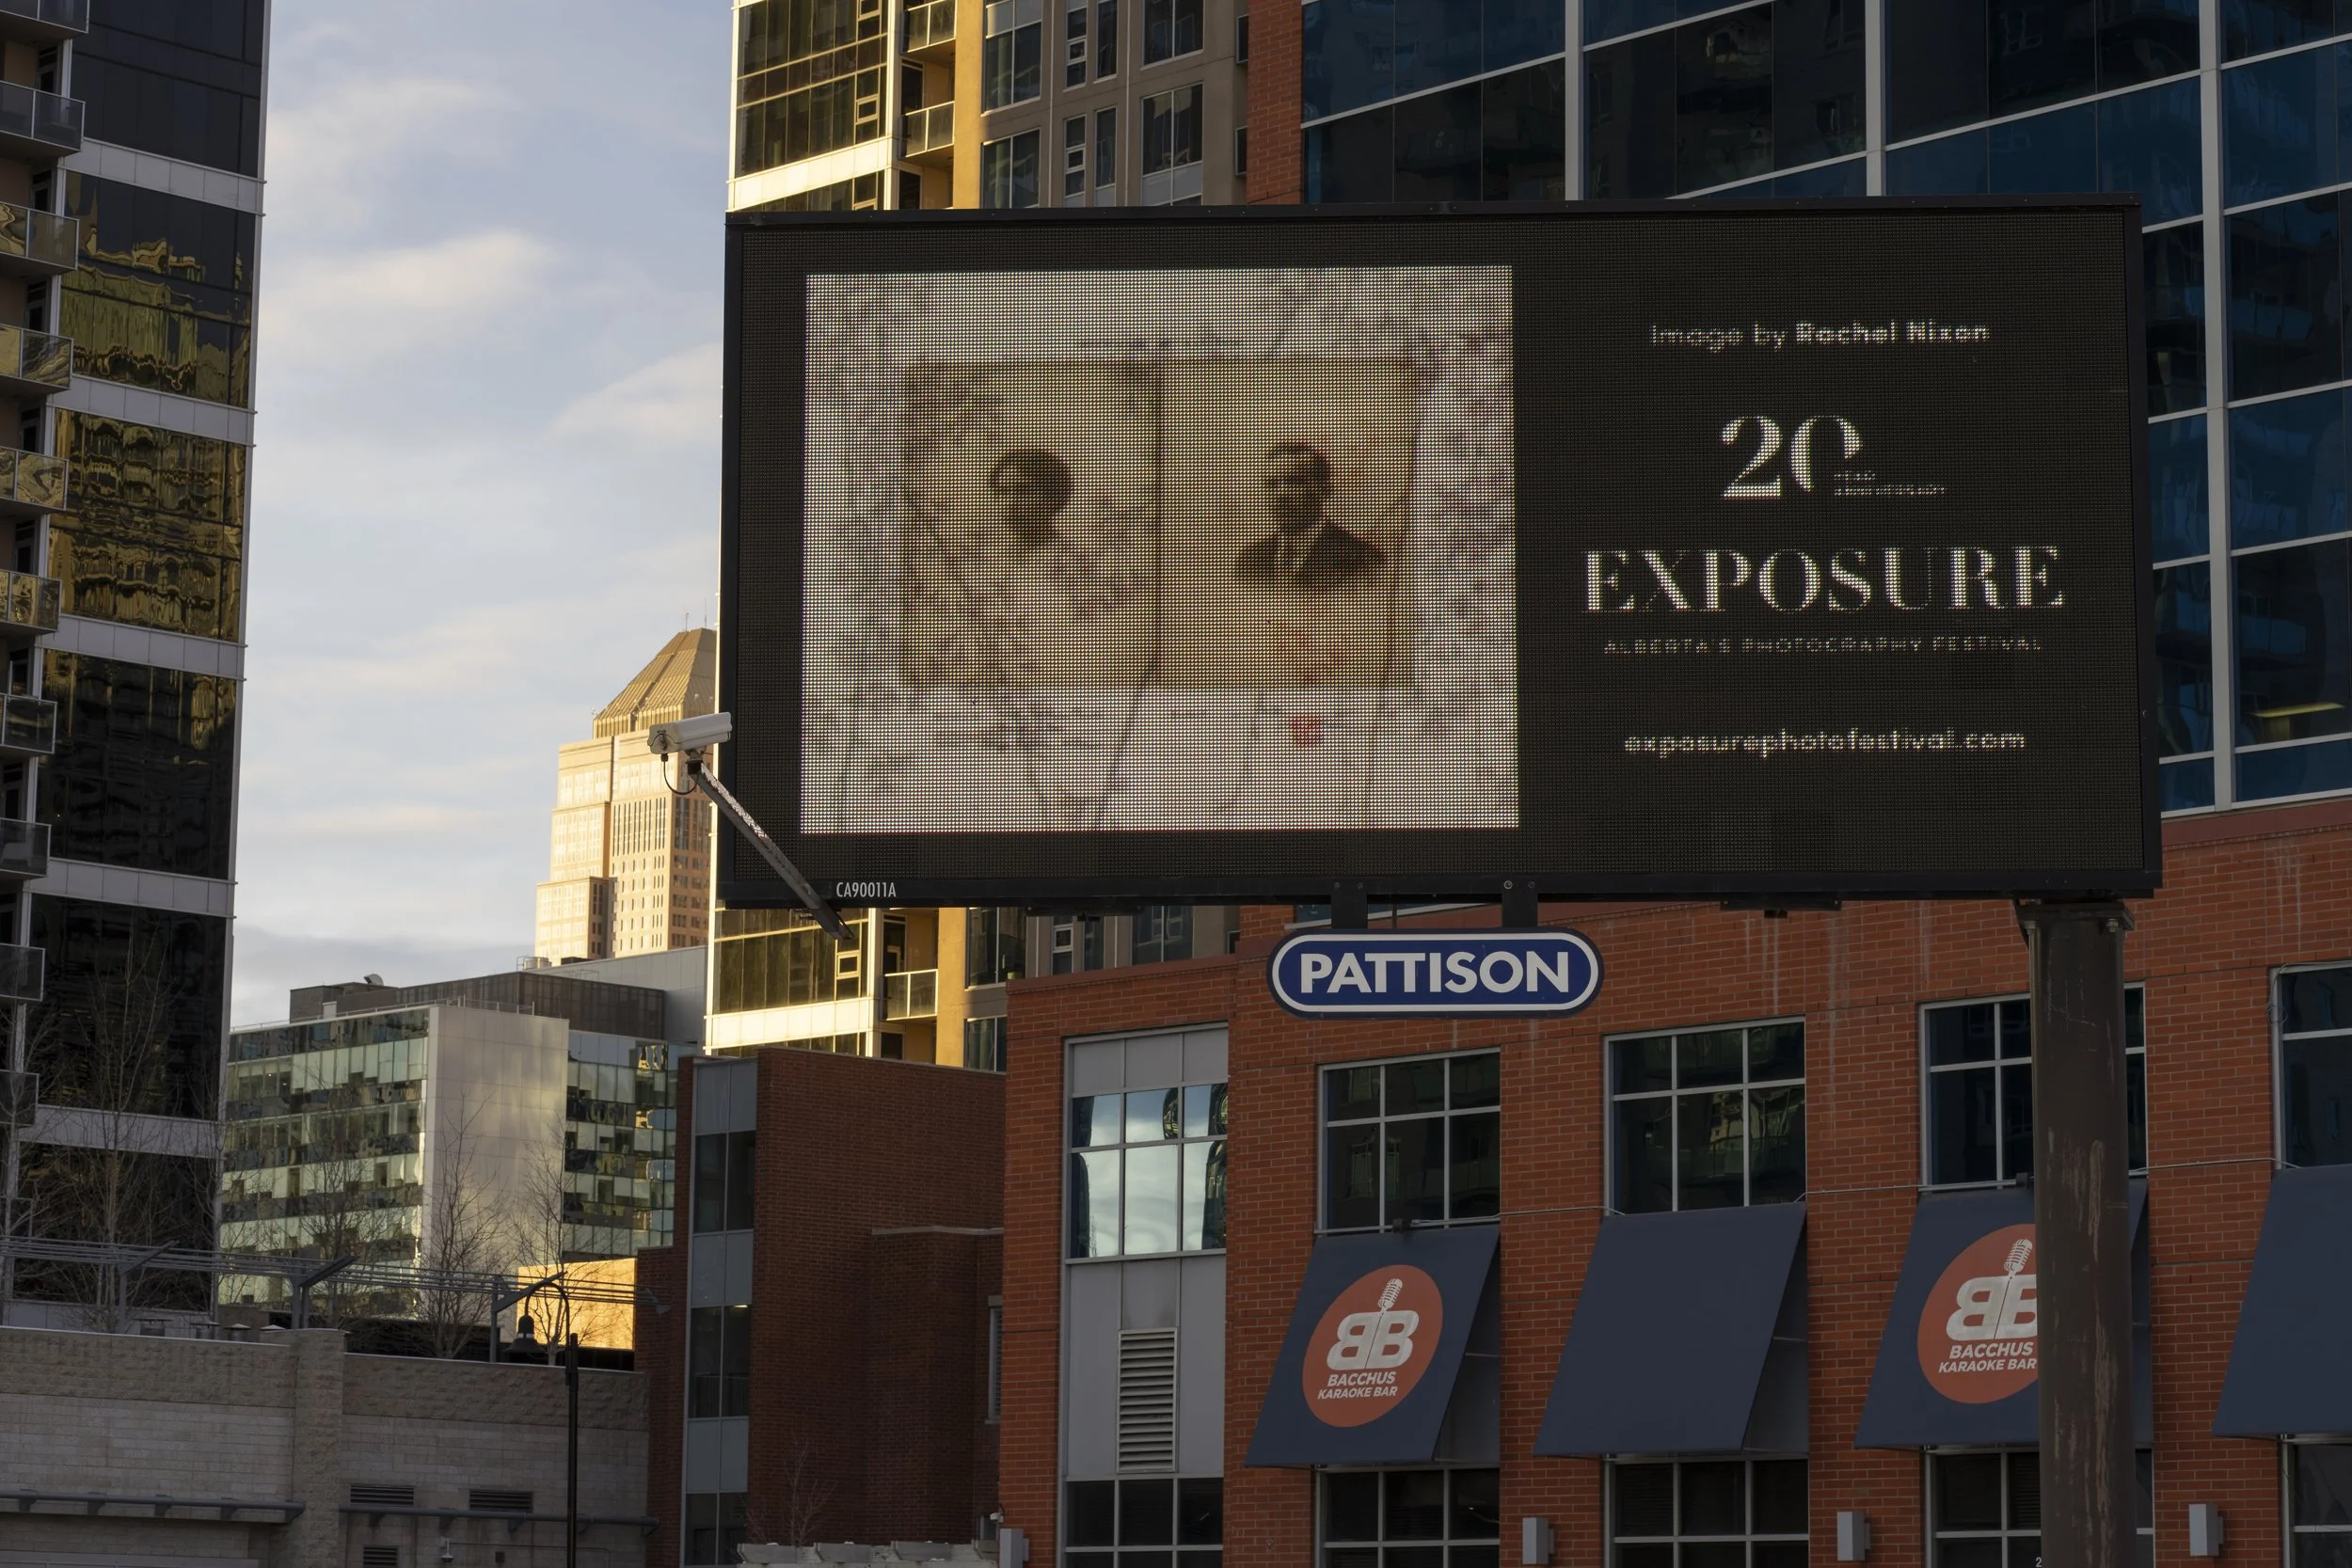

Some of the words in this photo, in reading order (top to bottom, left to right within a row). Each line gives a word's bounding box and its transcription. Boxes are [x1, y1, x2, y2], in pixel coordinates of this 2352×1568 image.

[1650, 325, 1742, 353] Image
[1754, 322, 1786, 352] by
[1795, 320, 1897, 344] Rachel
[1906, 318, 1991, 343] Nixon
[1720, 415, 1864, 499] 20
[1581, 546, 2064, 614] EXPOSURE
[1603, 638, 1731, 655] ALBERTA'S
[1741, 636, 1922, 654] PHOTOGRAPHY
[1932, 635, 2043, 653] FESTIVAL
[1623, 726, 2026, 758] exposurephotofestival.com
[835, 881, 897, 897] CA90011A
[1300, 950, 1569, 994] PATTISON
[1948, 1341, 2034, 1359] BACCHUS
[1938, 1359, 2005, 1373] KARAOKE
[2007, 1358, 2038, 1370] BAR
[1327, 1370, 1397, 1387] BACCHUS
[1317, 1387, 1372, 1400] KARAOKE
[1373, 1386, 1398, 1397] BAR
